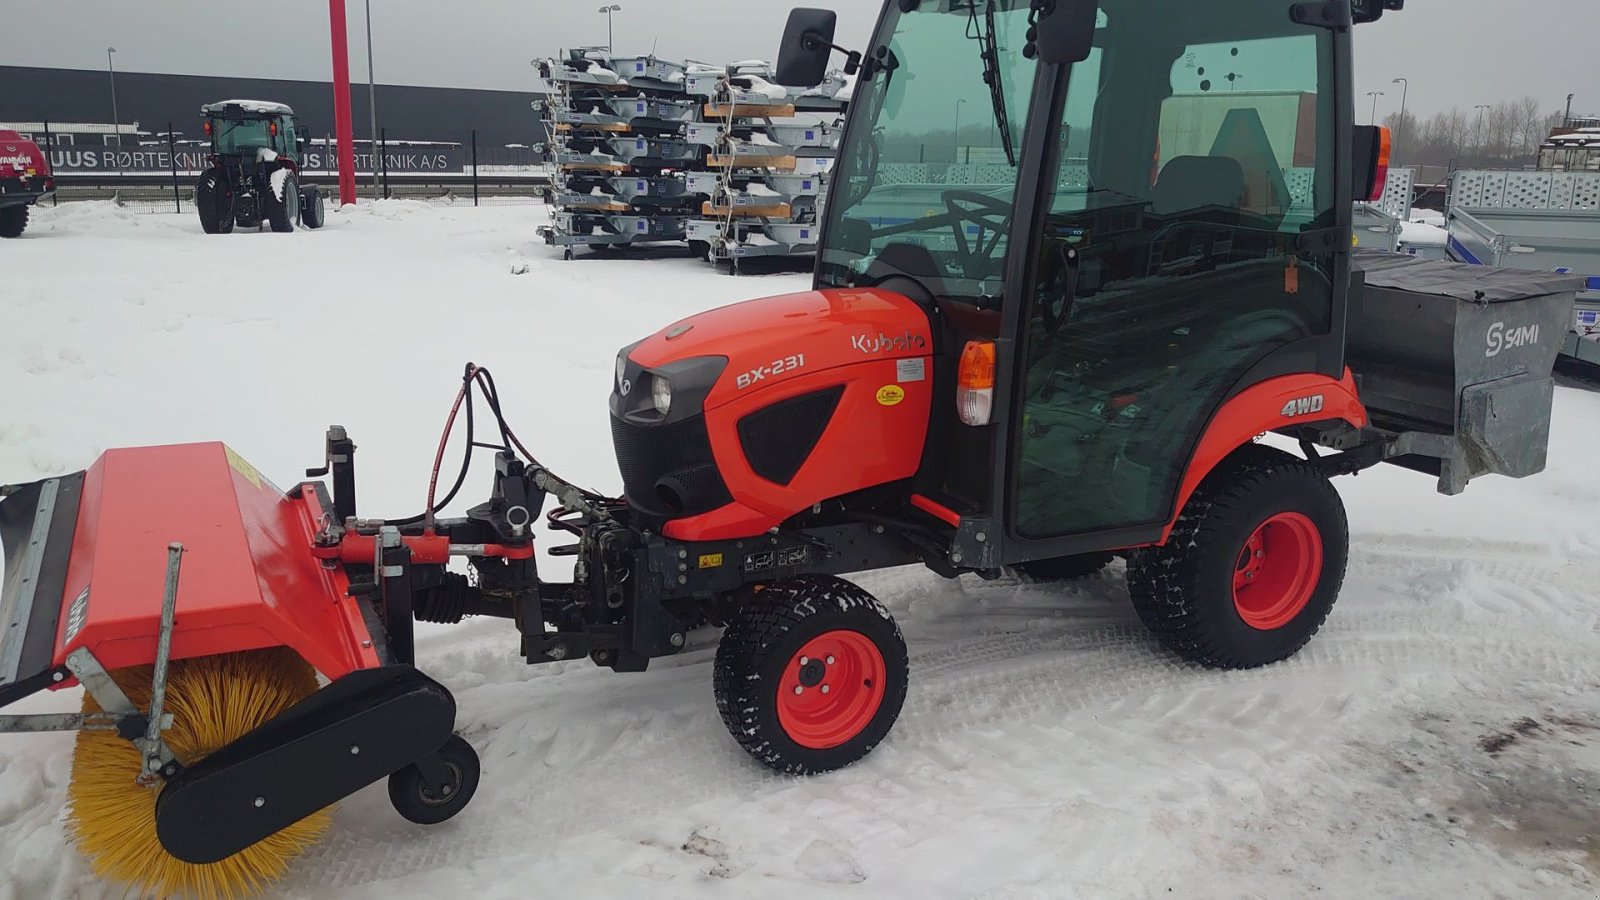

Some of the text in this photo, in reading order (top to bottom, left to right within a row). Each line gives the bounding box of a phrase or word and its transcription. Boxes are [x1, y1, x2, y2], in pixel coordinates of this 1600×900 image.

[41, 151, 215, 168] UUS RØRTEKNIK
[325, 154, 417, 169] RRTEKNIK
[420, 154, 448, 169] A/S
[851, 330, 926, 354] Kubota
[1504, 324, 1540, 350] SAMI
[736, 353, 806, 390] BX-231
[1280, 394, 1324, 418] 4WD
